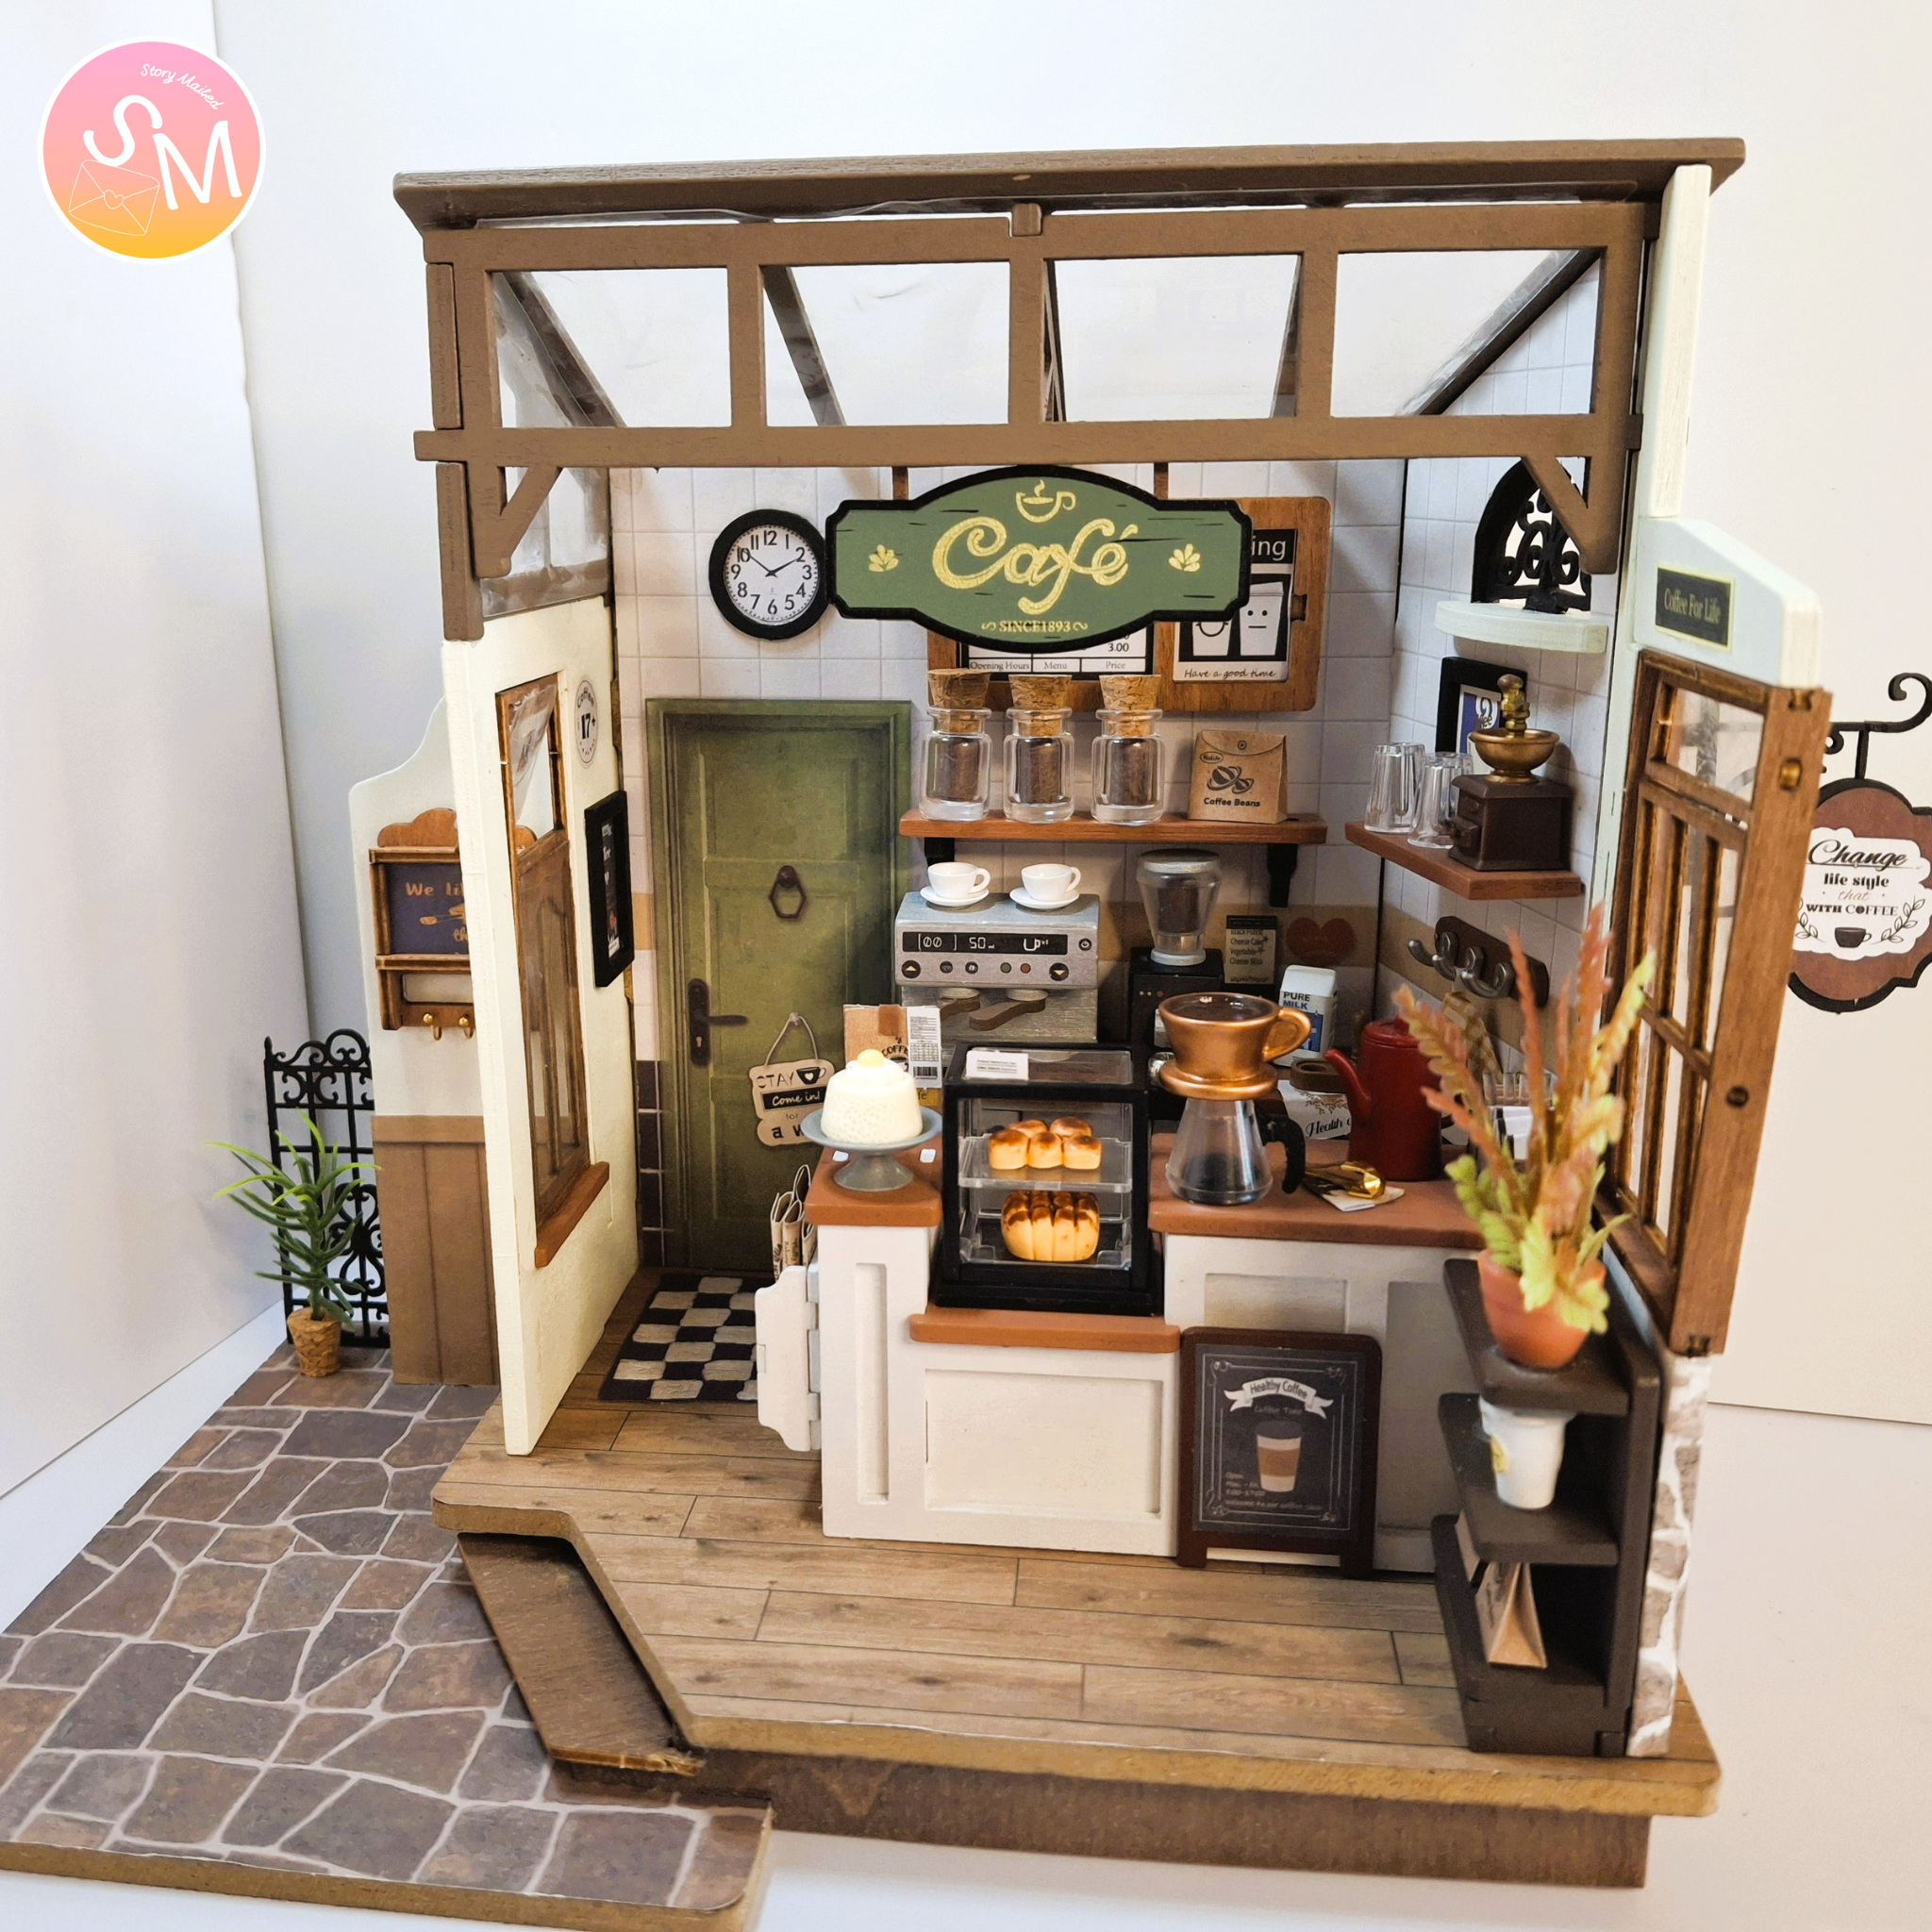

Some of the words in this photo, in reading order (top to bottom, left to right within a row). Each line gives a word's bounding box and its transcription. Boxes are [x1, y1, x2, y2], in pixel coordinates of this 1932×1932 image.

[1251, 535, 1287, 561] ing
[932, 516, 1139, 615] Café
[1108, 642, 1130, 653] 3.00
[970, 660, 1004, 671] Opening
[1005, 660, 1030, 671] Hours
[1043, 660, 1068, 671] Menu
[1106, 659, 1126, 671] Price
[1184, 669, 1210, 678] Have
[1223, 669, 1249, 680] good
[1250, 669, 1276, 678] time
[1203, 797, 1232, 806] Coffee
[1234, 799, 1261, 808] Beans
[1807, 839, 1908, 873] Change
[1824, 873, 1849, 886] life
[1852, 874, 1890, 891] style
[405, 882, 434, 896] We
[1838, 889, 1871, 901] that
[1806, 904, 1842, 913] WITH
[1284, 991, 1310, 1002] PURE
[1283, 1000, 1308, 1010] MILK
[772, 1095, 803, 1106] Come
[772, 1126, 784, 1139] a
[1250, 1379, 1281, 1394] Healthy
[1283, 1380, 1307, 1399] Coffee
